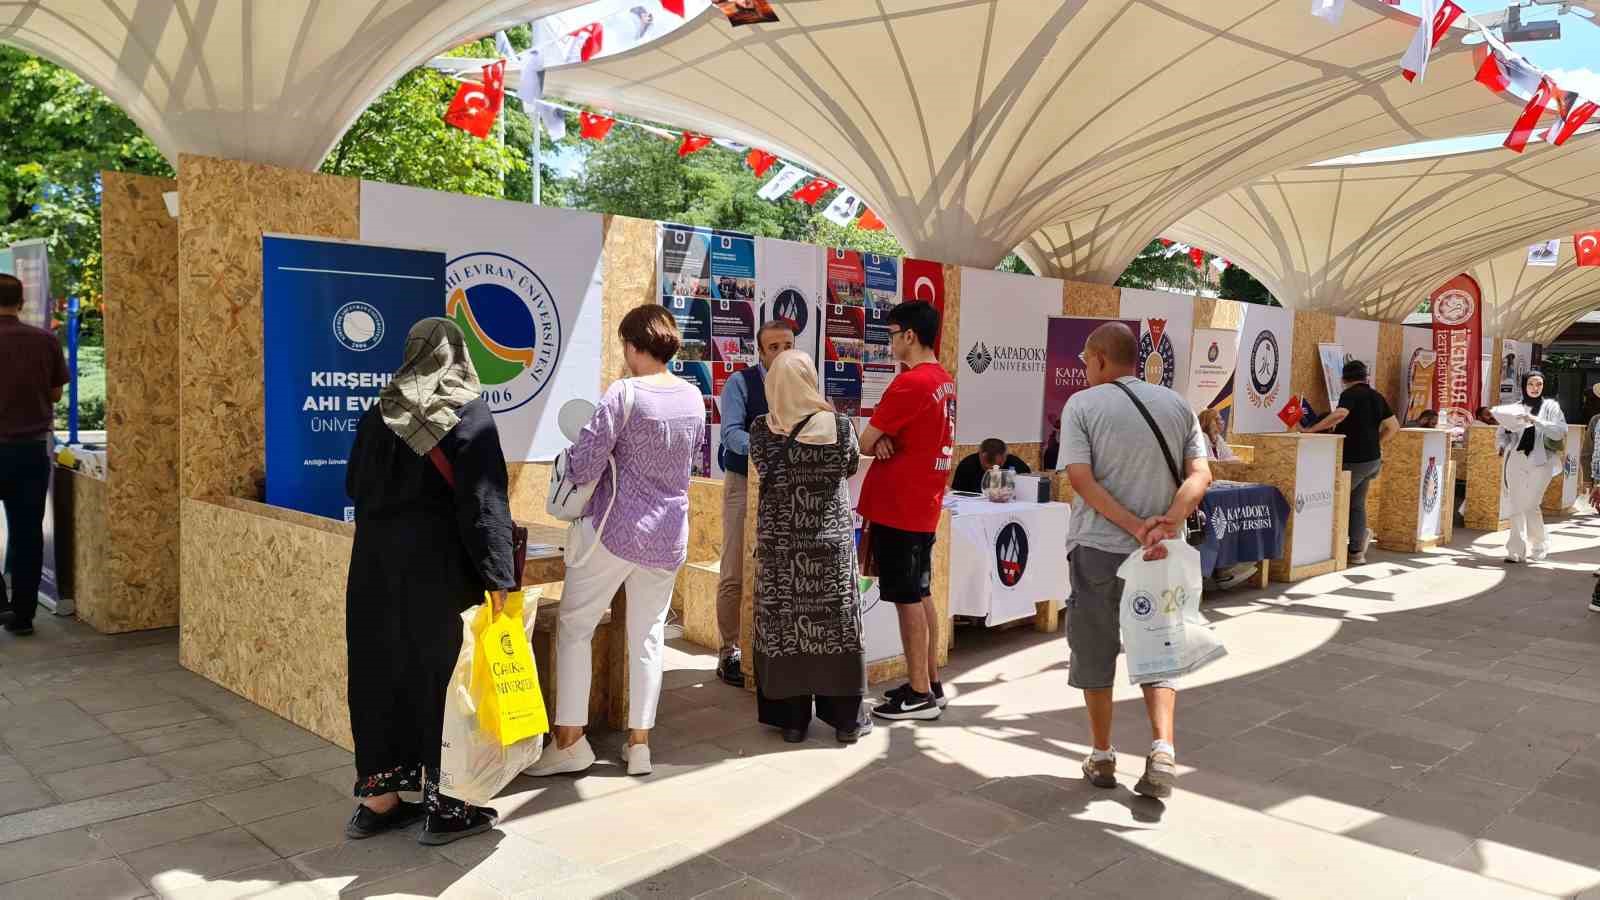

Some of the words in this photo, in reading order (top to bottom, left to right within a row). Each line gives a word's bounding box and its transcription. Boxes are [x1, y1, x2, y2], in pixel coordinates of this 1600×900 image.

[464, 263, 515, 281] EVRAN
[518, 275, 554, 382] ÜNİVERSİTESİ
[311, 371, 395, 389] KIRŞEHI
[1056, 367, 1088, 378] KAPA
[346, 396, 381, 411] EV
[311, 416, 360, 432] ÜNİVE
